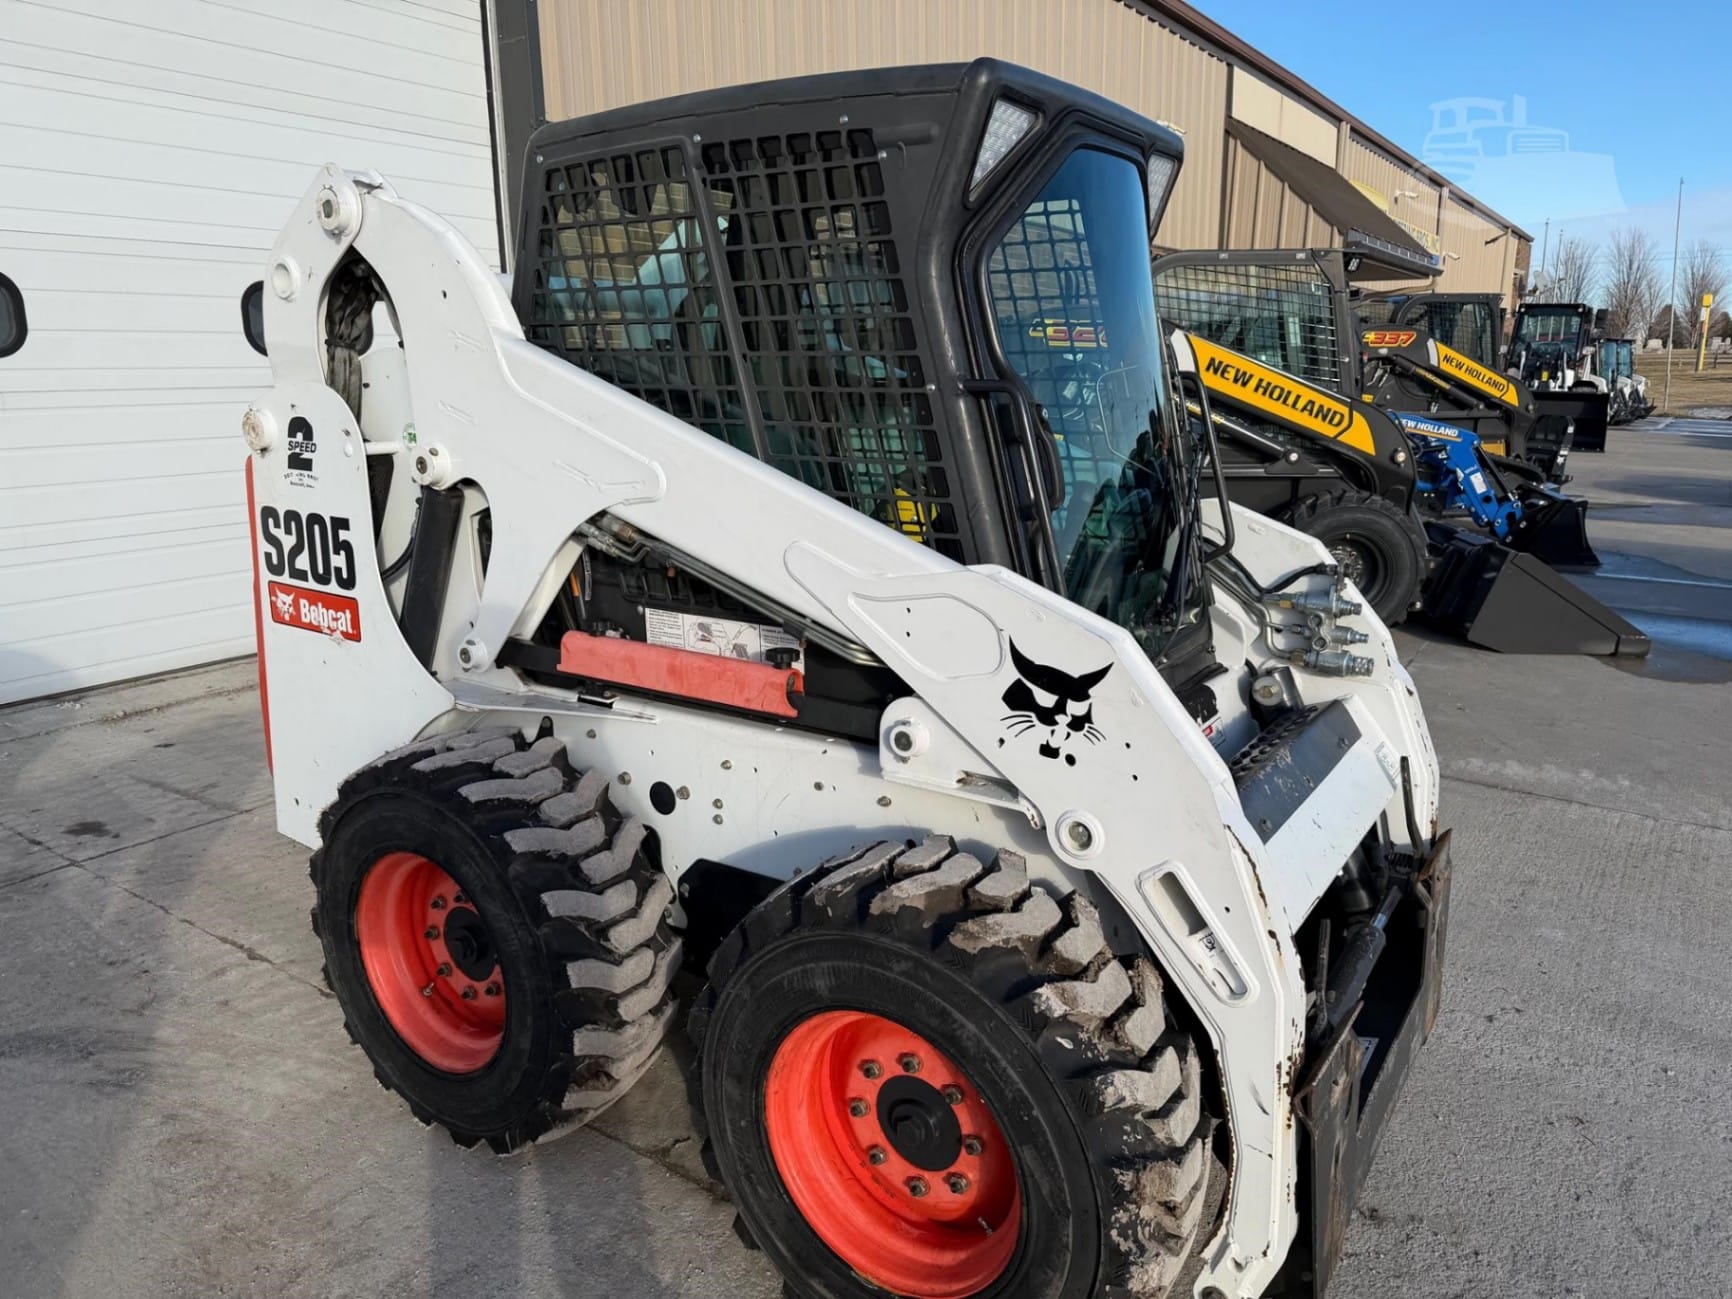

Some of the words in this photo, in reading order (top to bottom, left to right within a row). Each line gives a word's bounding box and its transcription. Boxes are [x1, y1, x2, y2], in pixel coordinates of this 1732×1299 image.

[1442, 354, 1466, 372] NEW
[1464, 365, 1506, 392] HOLLAND
[1205, 357, 1254, 388] NEW
[1253, 378, 1345, 428] HOLLAND
[287, 440, 317, 453] SPEED
[288, 416, 313, 471] 2
[1416, 422, 1459, 437] HOLLAND
[260, 505, 356, 591] S205
[299, 598, 353, 634] Bobcat
